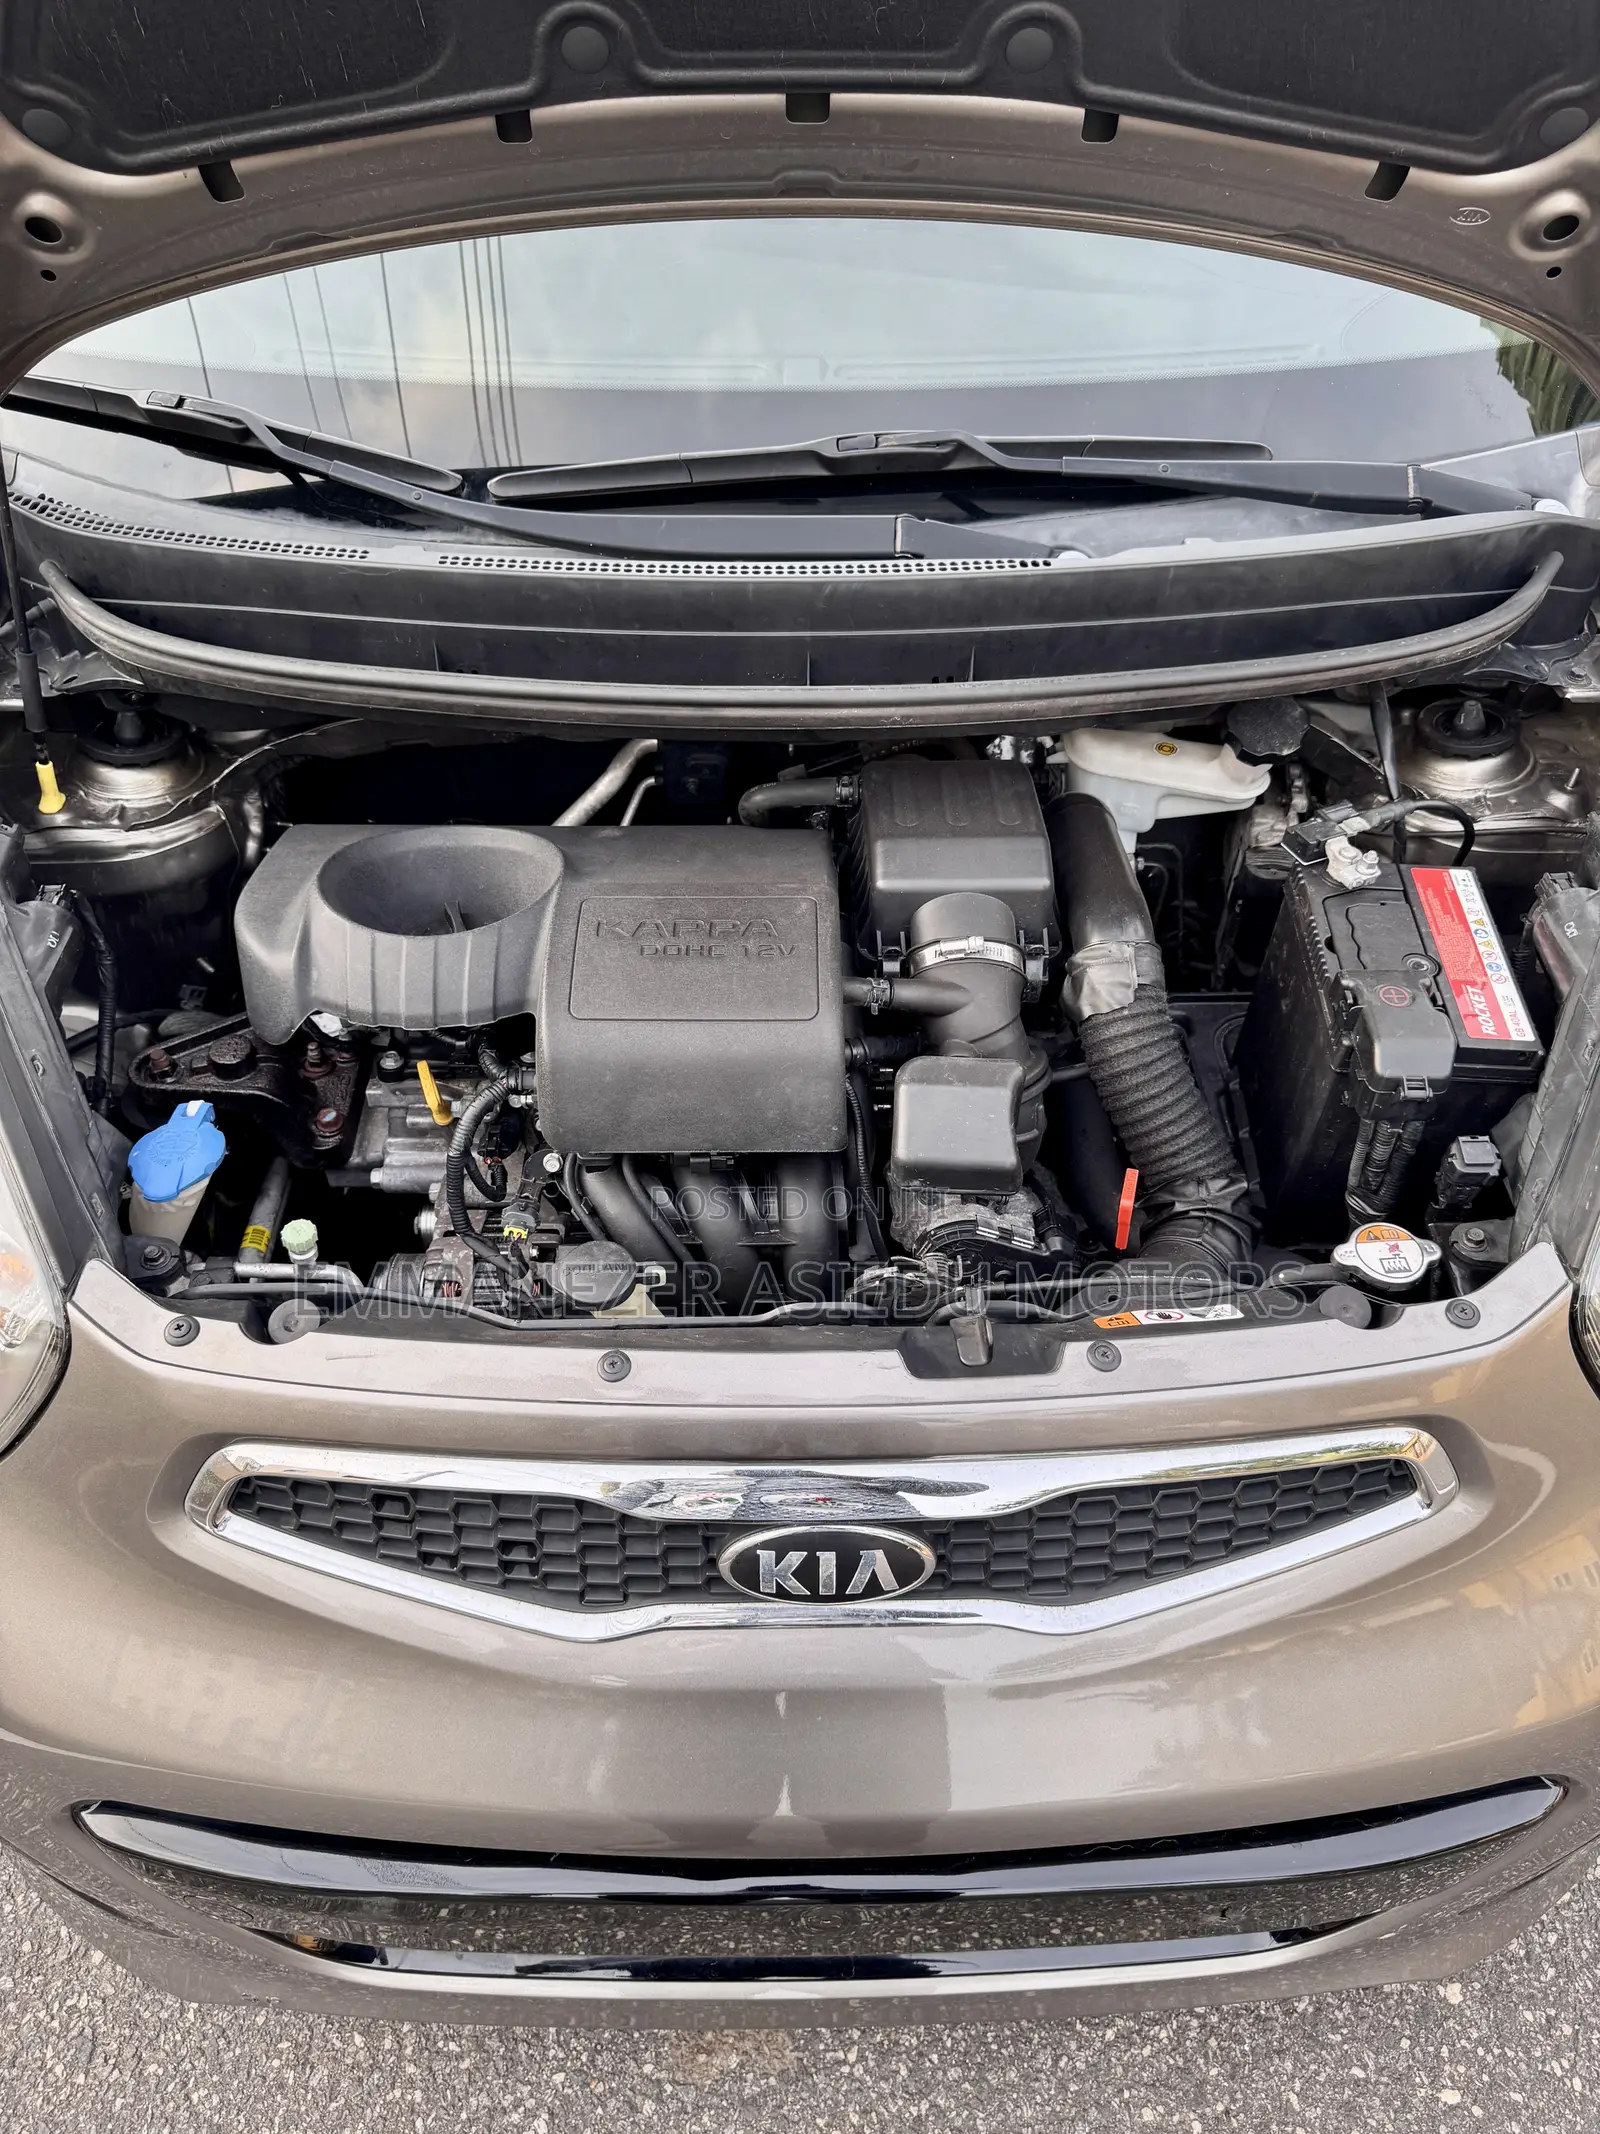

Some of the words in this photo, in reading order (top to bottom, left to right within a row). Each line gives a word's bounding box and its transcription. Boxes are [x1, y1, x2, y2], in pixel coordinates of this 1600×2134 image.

[596, 918, 778, 938] KAPPA
[640, 943, 726, 957] DOHC
[742, 943, 797, 957] 12V
[1466, 984, 1500, 1037] ROCKET
[756, 1549, 900, 1596] KIA
